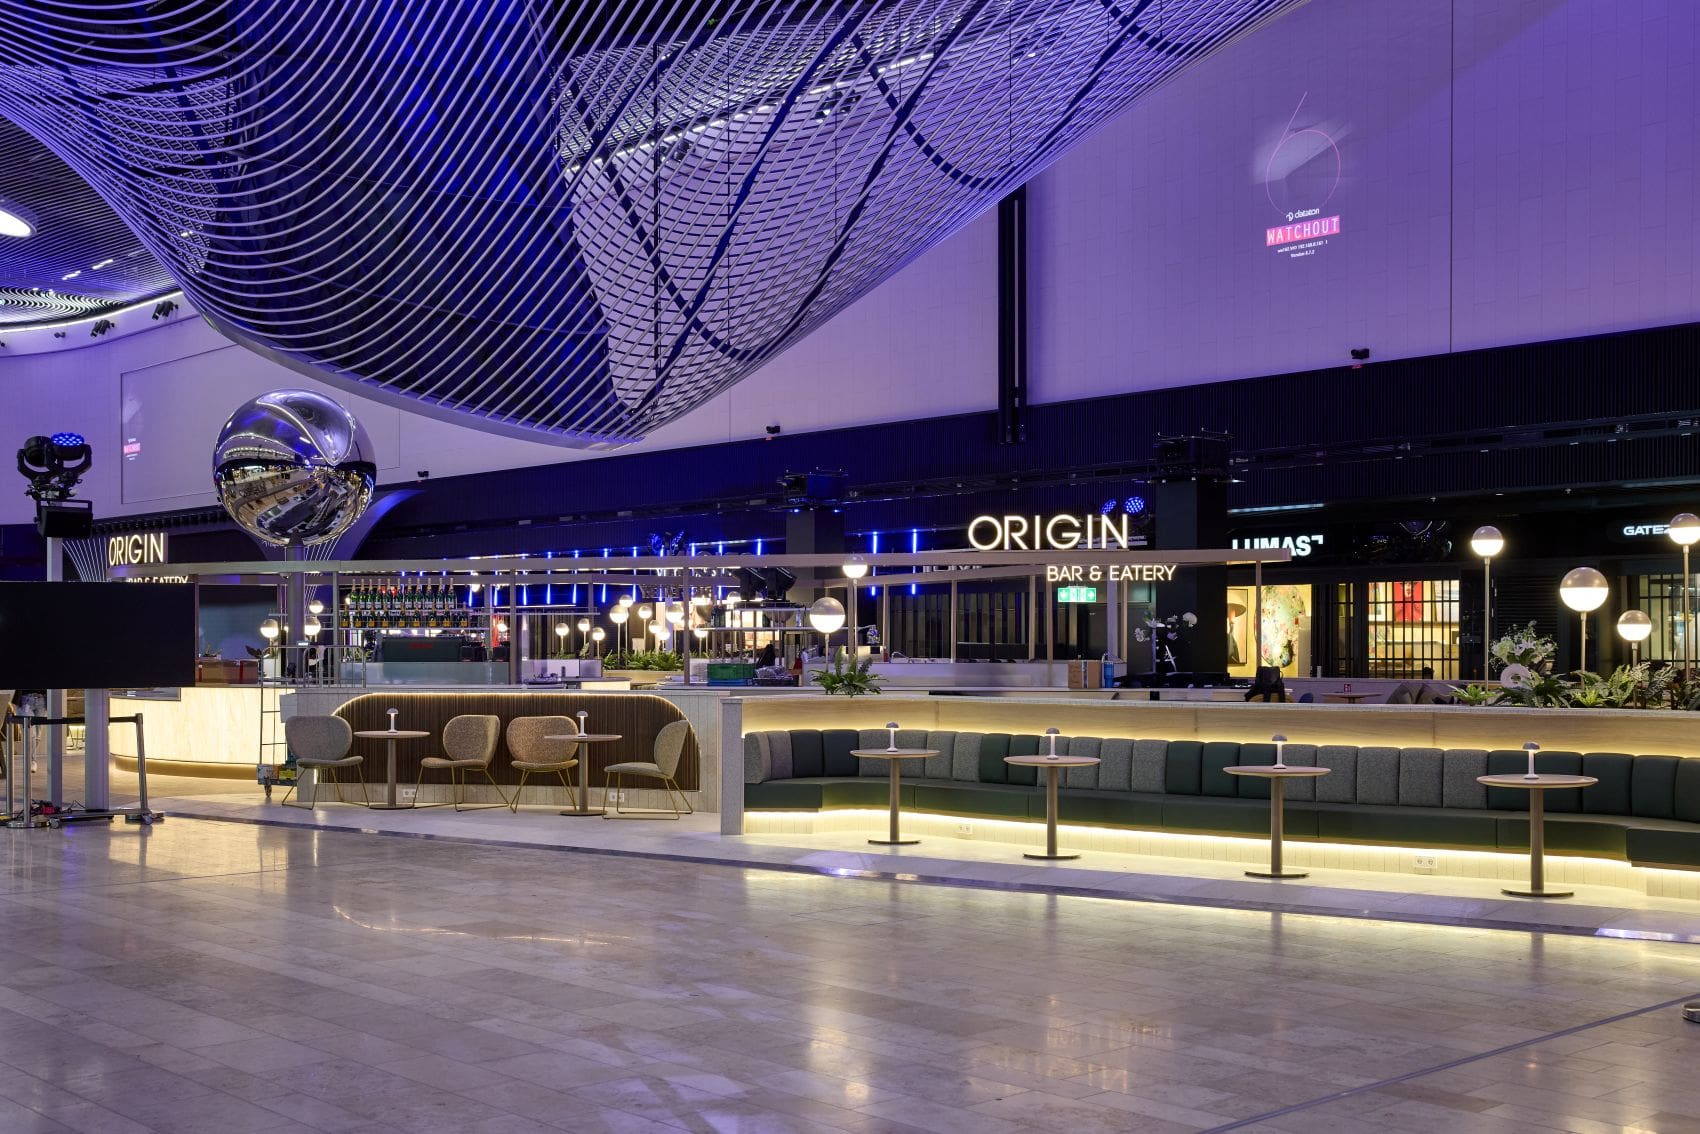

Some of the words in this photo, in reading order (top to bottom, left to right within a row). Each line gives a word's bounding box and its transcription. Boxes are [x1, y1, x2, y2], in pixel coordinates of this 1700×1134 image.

[1294, 208, 1320, 219] dataton
[1266, 217, 1339, 244] WATCHOUT
[968, 513, 1128, 550] ORIGIN
[108, 532, 164, 566] ORIGIN
[1047, 565, 1082, 582] BAR
[1089, 565, 1102, 581] &
[1109, 564, 1177, 581] EATERY
